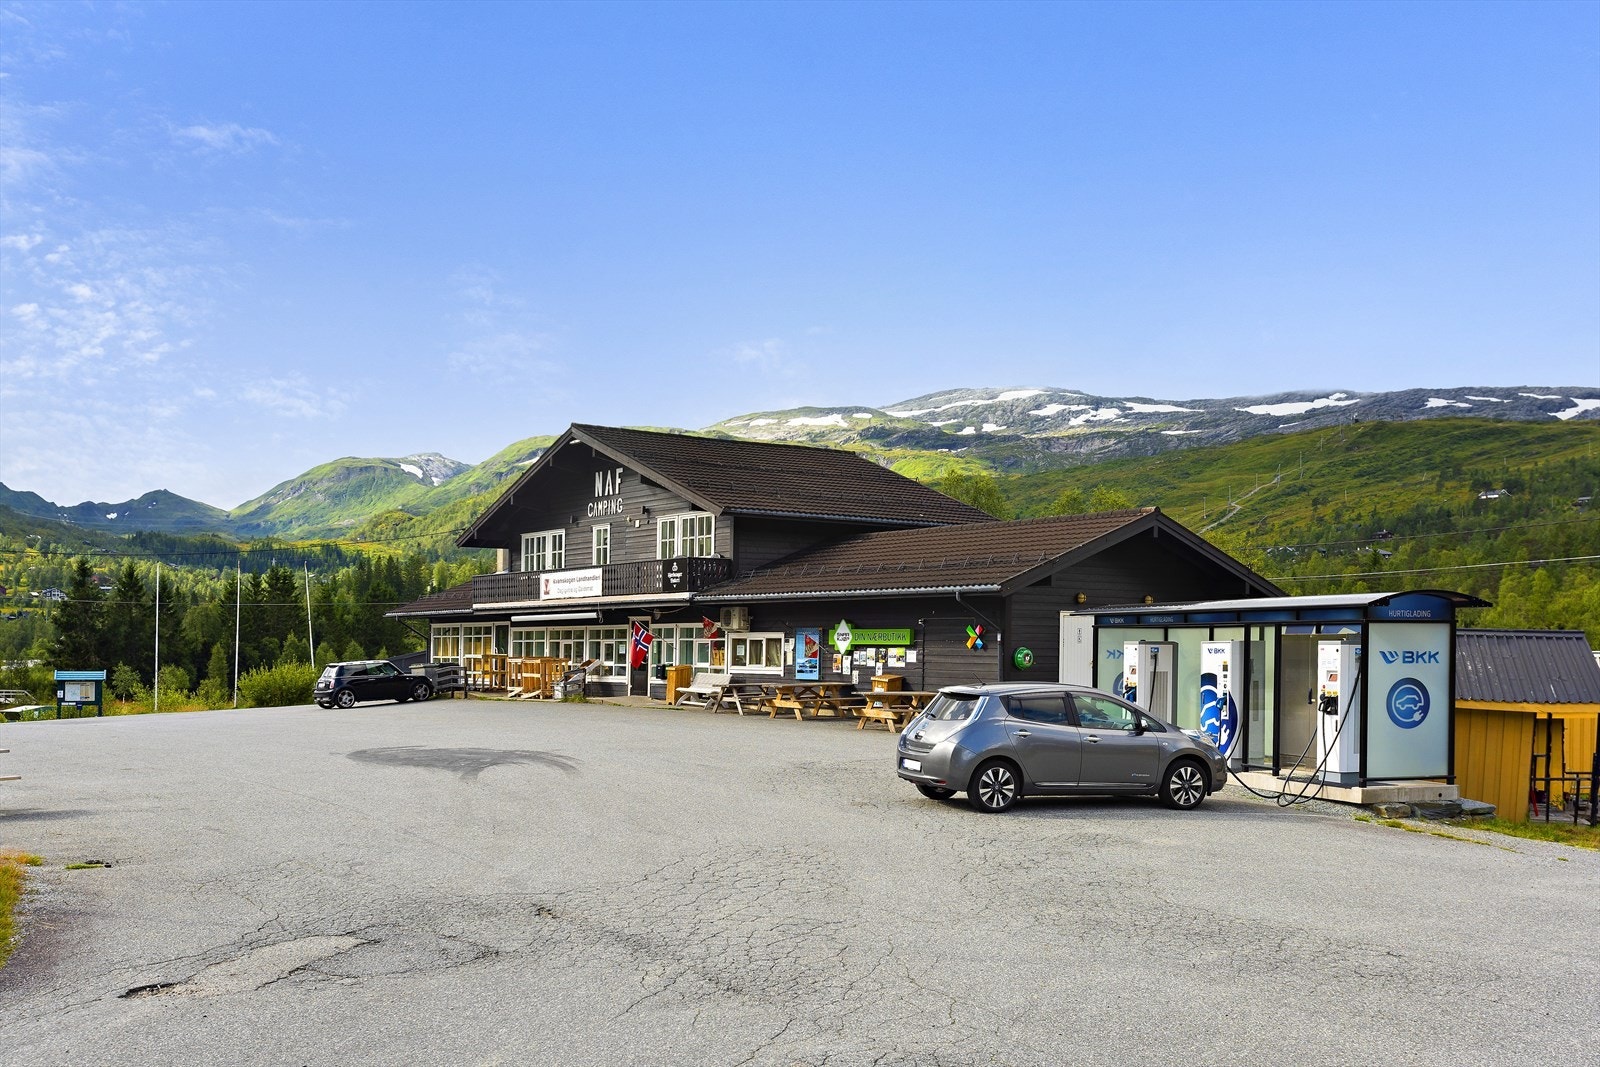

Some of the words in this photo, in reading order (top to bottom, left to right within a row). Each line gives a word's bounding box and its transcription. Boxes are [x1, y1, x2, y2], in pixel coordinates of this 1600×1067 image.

[595, 467, 623, 497] NAF
[587, 497, 623, 517] CAMPING
[1388, 609, 1431, 618] HURTIGLADING
[854, 632, 865, 641] DIN
[867, 632, 907, 641] NÆRBUTIKK
[1402, 650, 1440, 664] BKK
